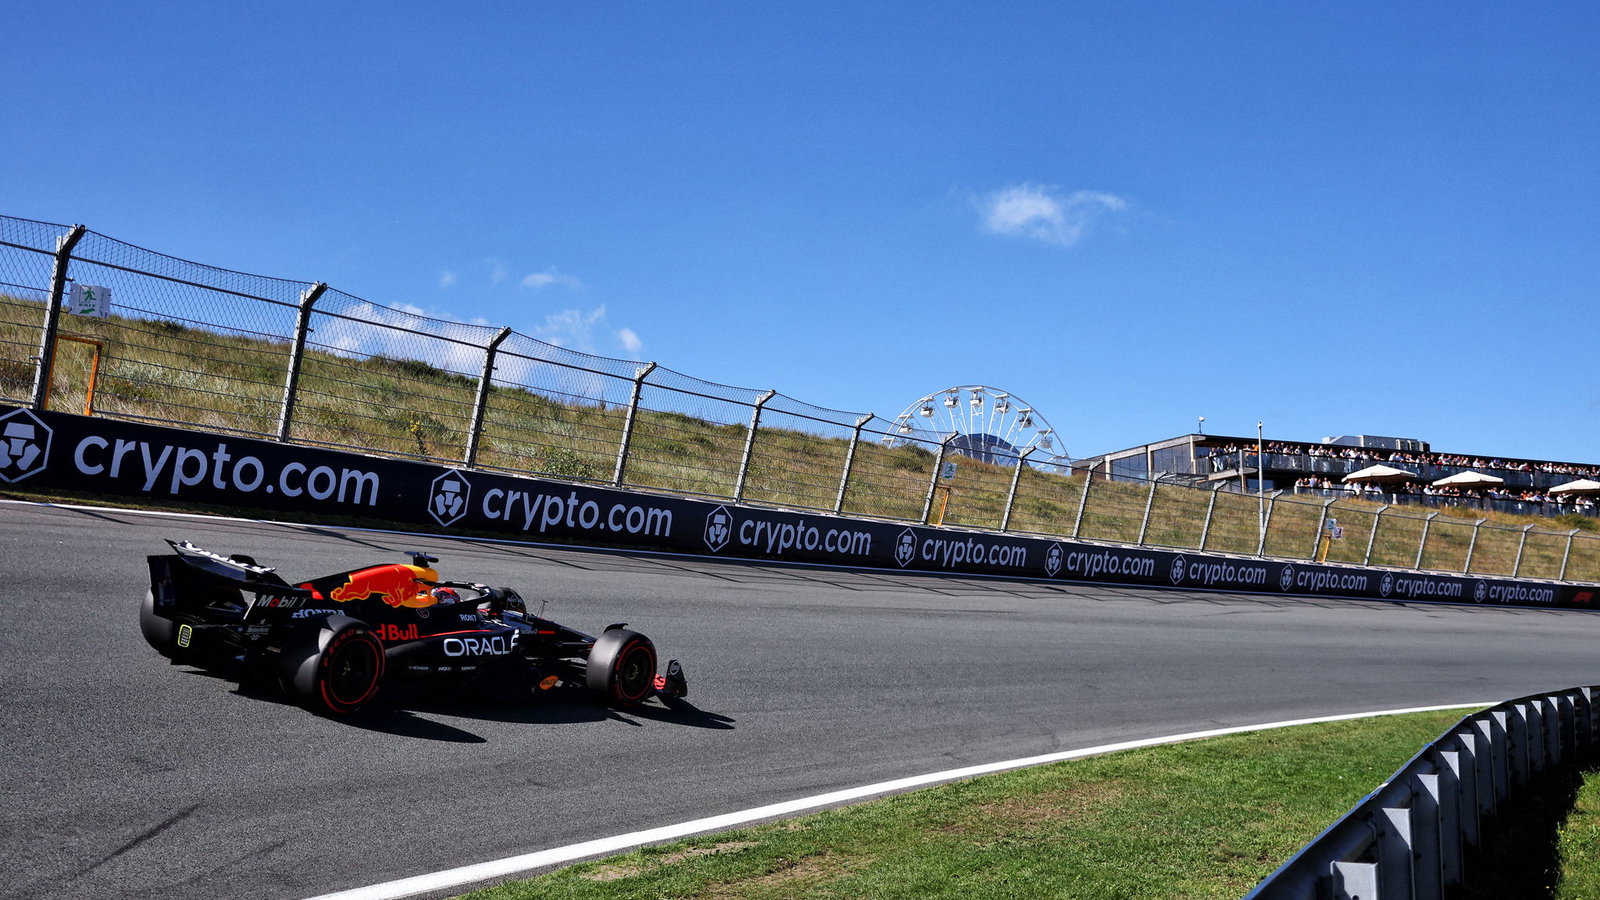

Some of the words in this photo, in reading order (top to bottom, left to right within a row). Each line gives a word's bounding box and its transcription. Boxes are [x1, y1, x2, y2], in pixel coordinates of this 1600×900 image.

[75, 436, 379, 505] crypto.com
[483, 489, 672, 536] crypto.com
[740, 520, 871, 555] crypto.com
[923, 538, 1026, 568] crypto.com
[1067, 551, 1154, 577] crypto.com
[1189, 562, 1266, 585] crypto.com
[1297, 570, 1367, 591] crypto.com
[1396, 578, 1461, 597] crypto.com
[1489, 585, 1552, 602] crypto.com
[256, 594, 298, 608] Mobil
[387, 623, 419, 641] Bull
